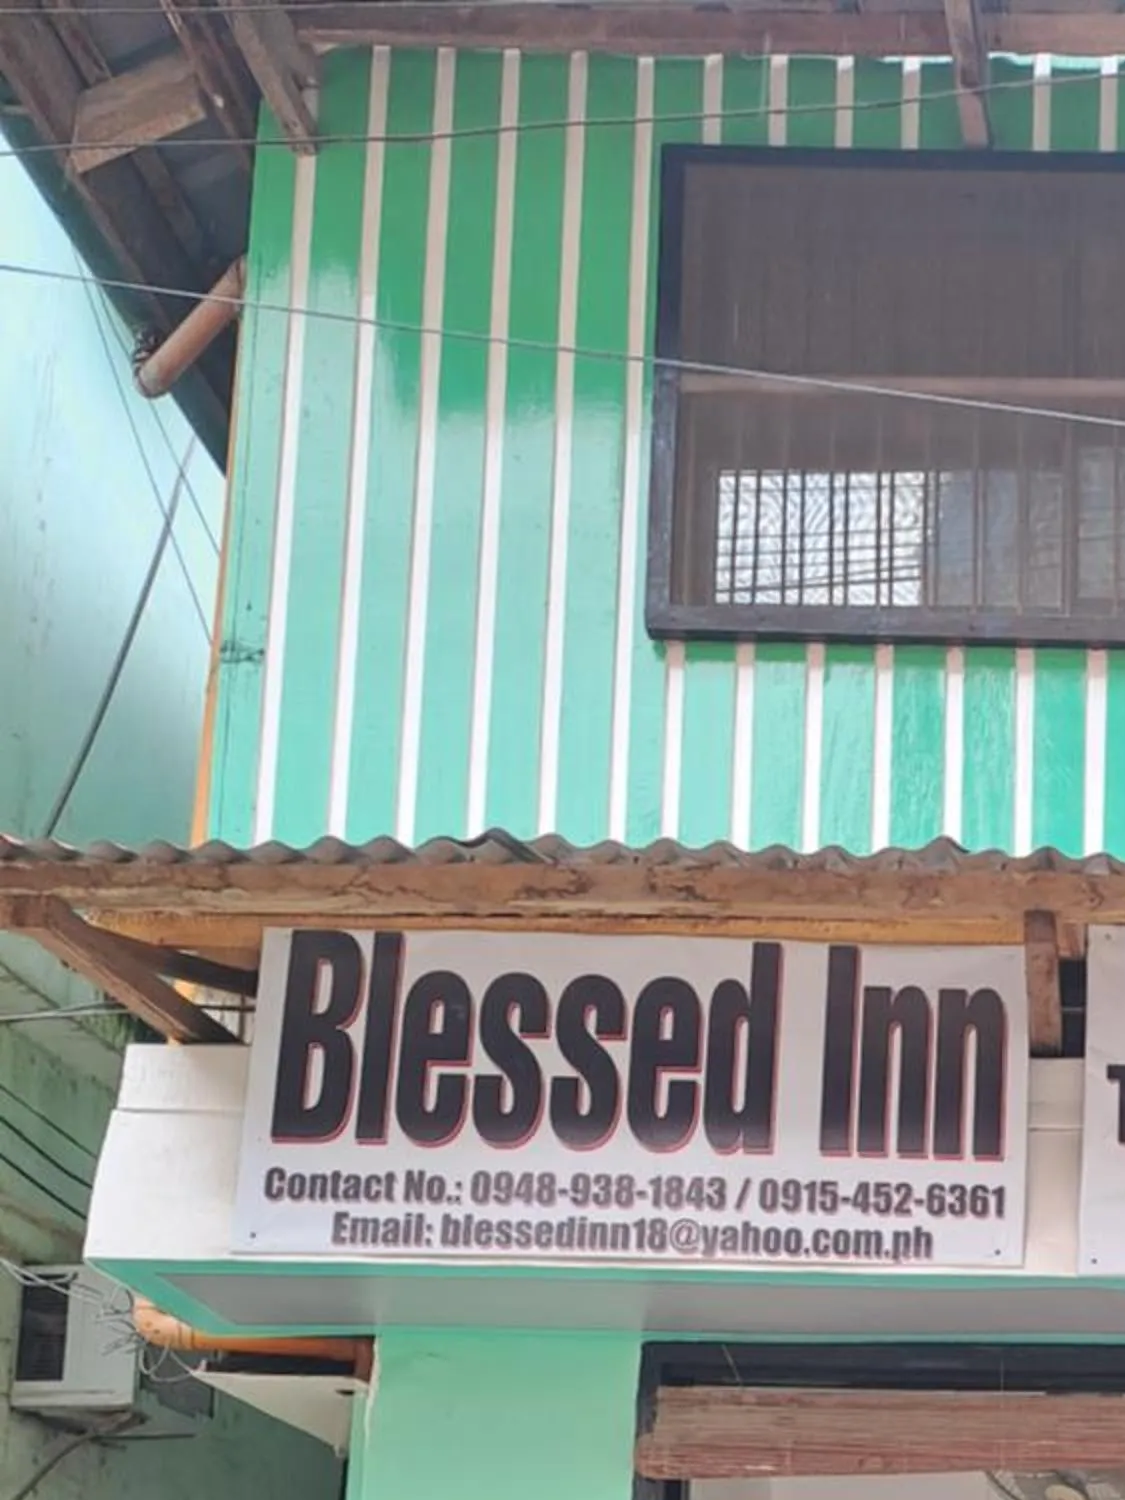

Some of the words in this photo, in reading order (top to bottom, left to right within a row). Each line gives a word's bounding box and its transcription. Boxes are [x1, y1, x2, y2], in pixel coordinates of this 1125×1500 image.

[271, 928, 782, 1156] Blessed
[818, 944, 1007, 1161] Inn
[264, 1167, 398, 1203] Contact
[403, 1169, 462, 1205] No.:
[470, 1170, 726, 1211] 0948-938-1843
[735, 1177, 752, 1212] /
[758, 1178, 1006, 1219] 0915-452-6361
[331, 1211, 434, 1247] Email:
[440, 1213, 933, 1263] blessedinn18@yahoo.com.ph
